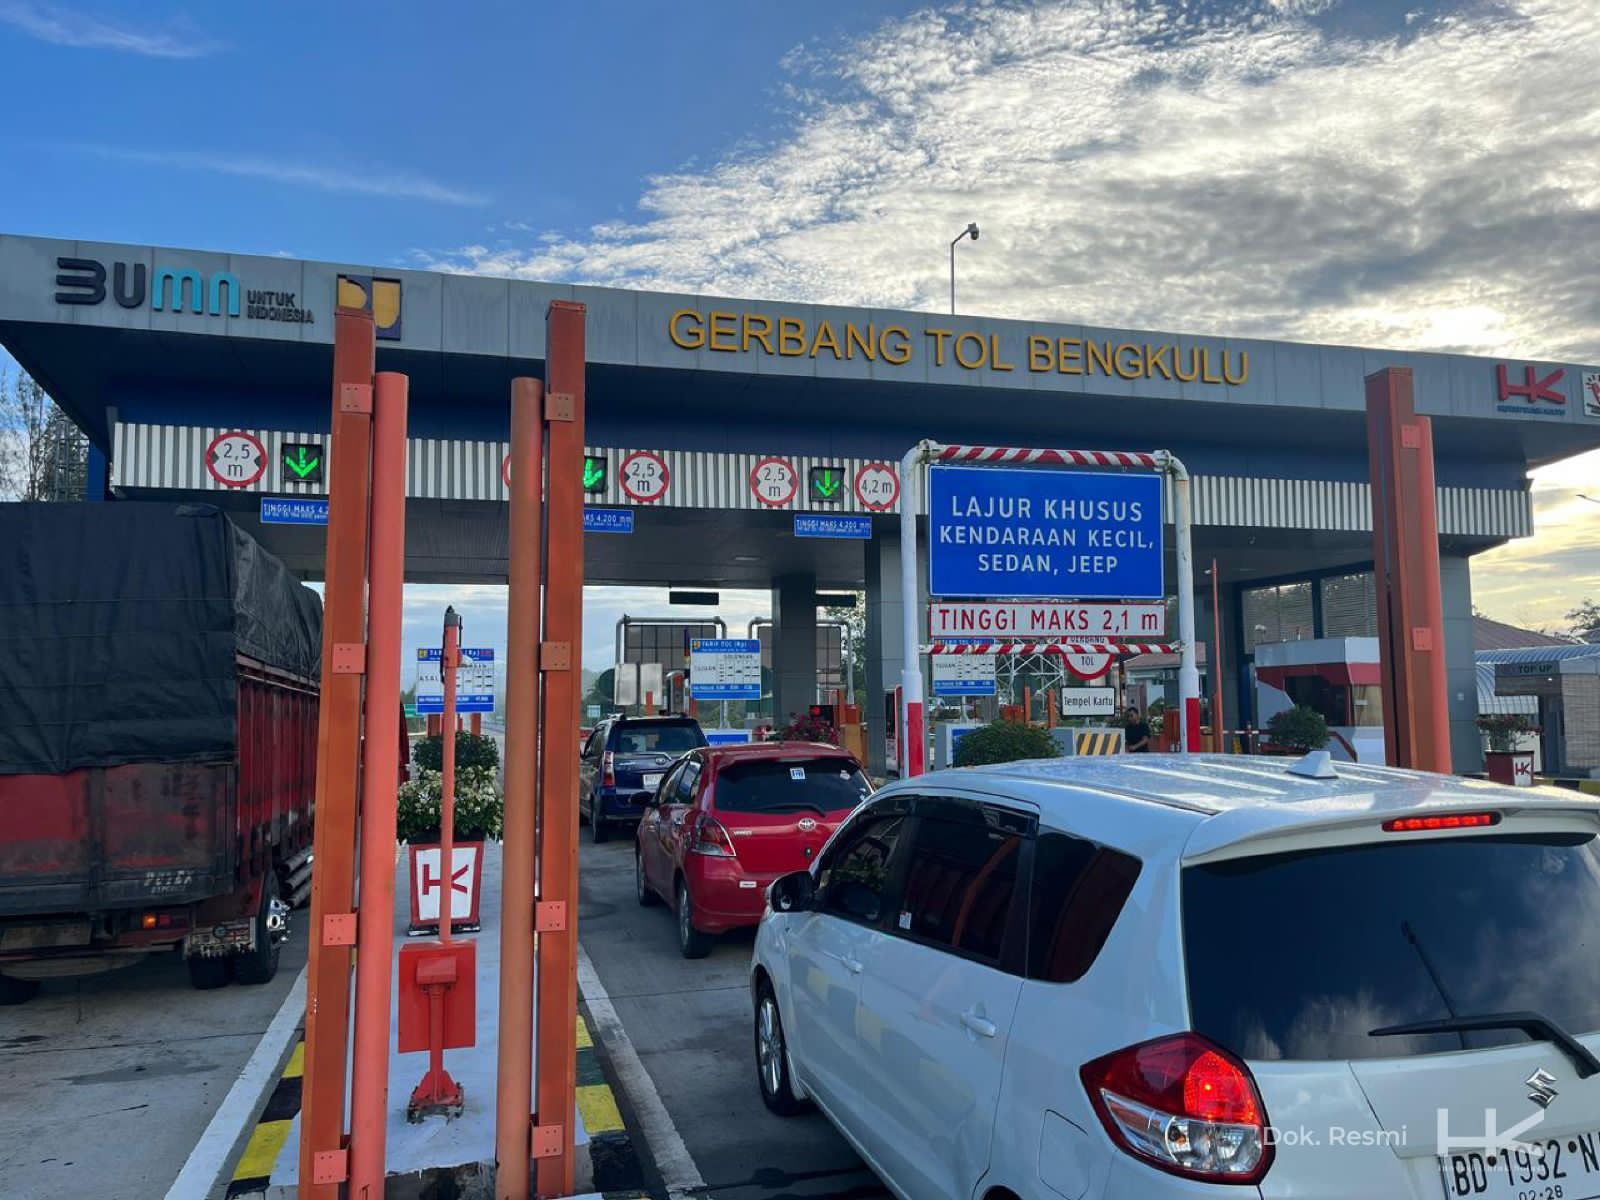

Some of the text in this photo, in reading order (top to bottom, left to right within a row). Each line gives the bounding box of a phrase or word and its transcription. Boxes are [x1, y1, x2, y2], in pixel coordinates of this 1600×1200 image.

[247, 289, 296, 308] UNTUK
[247, 305, 315, 325] INDONESIA
[668, 308, 1250, 386] GERBANG TOL BENGKULU
[1496, 364, 1567, 404] HK
[223, 442, 251, 461] 2,5
[228, 463, 243, 477] m
[631, 462, 655, 478] 2,5
[763, 466, 786, 484] 2,5
[637, 479, 651, 493] m
[768, 485, 781, 497] m
[861, 479, 893, 494] 4,2 m
[952, 496, 1143, 522] LAJUR KHUSUS
[940, 525, 1153, 549] KENDARAAN KECIL,
[978, 553, 1118, 576] SEDAN, JEEP
[939, 609, 1158, 633] TINGGI MAKS 2,1 m
[1064, 696, 1113, 708] Tempel Kartu
[1515, 762, 1530, 776] HK
[1452, 1132, 1600, 1197] BD 1932 N
